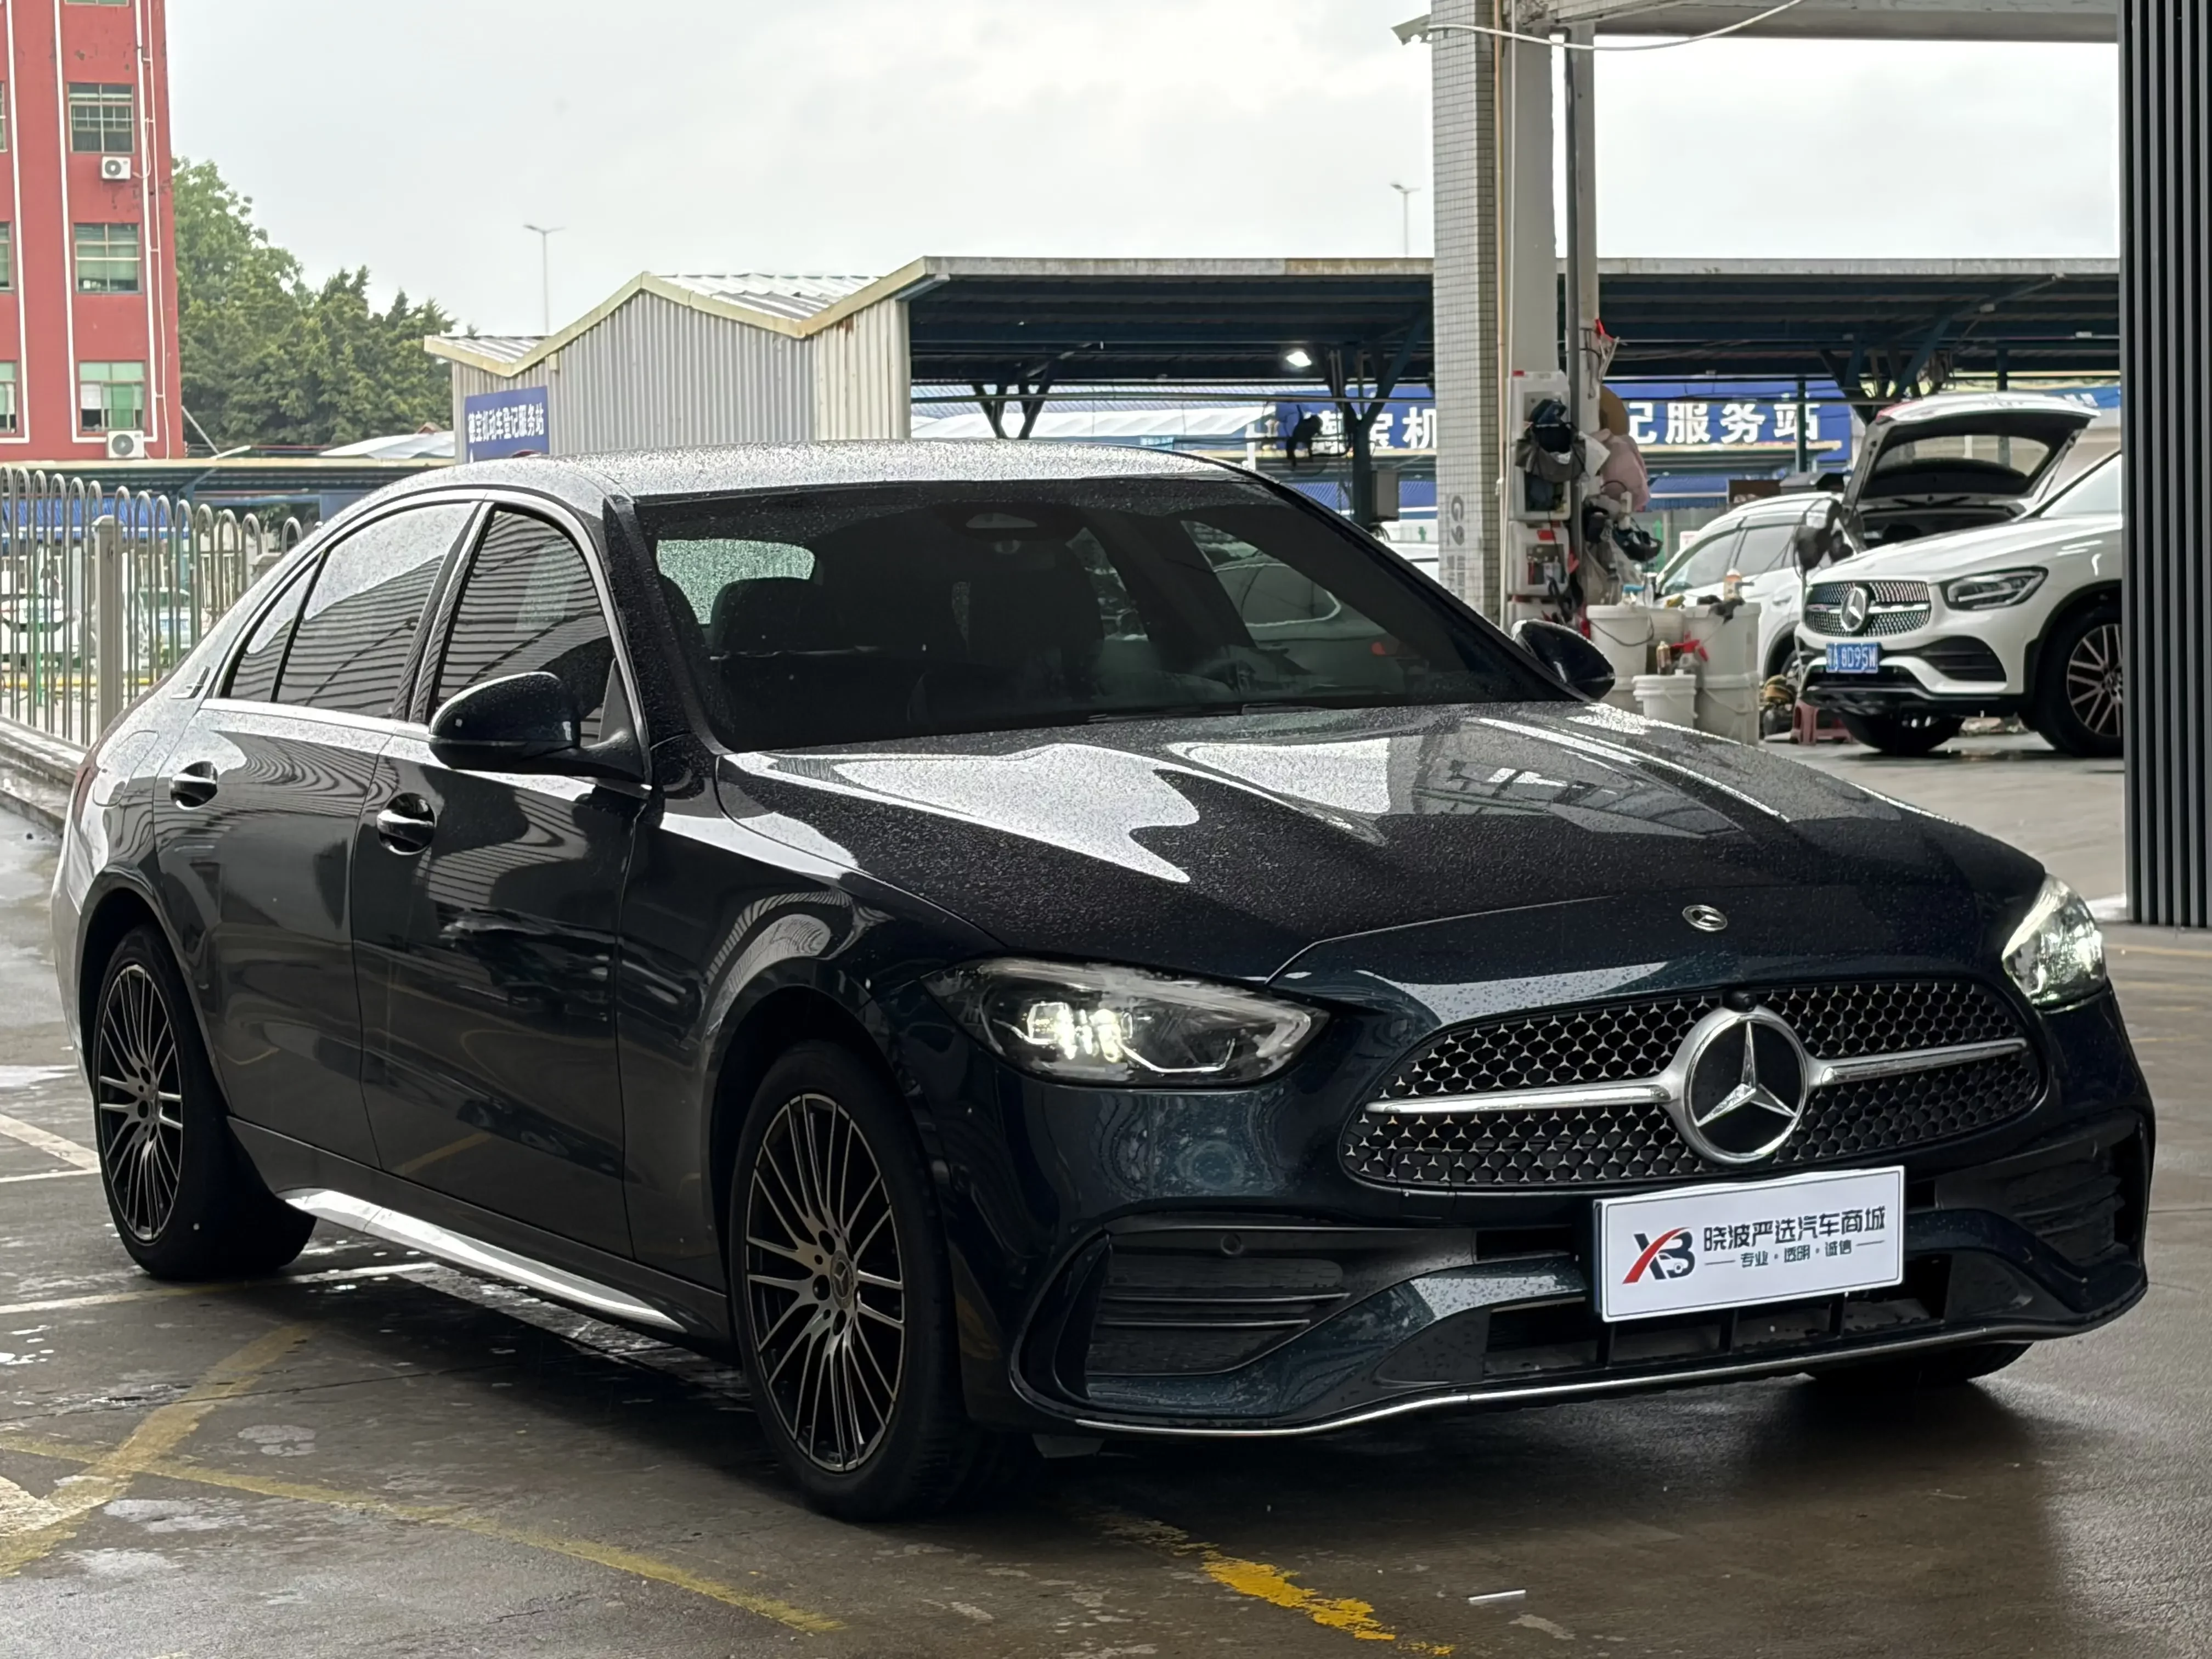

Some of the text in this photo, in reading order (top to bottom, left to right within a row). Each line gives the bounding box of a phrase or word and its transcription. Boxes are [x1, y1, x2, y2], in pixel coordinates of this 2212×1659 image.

[1703, 1206, 1886, 1252] 晓波严选汽车商城
